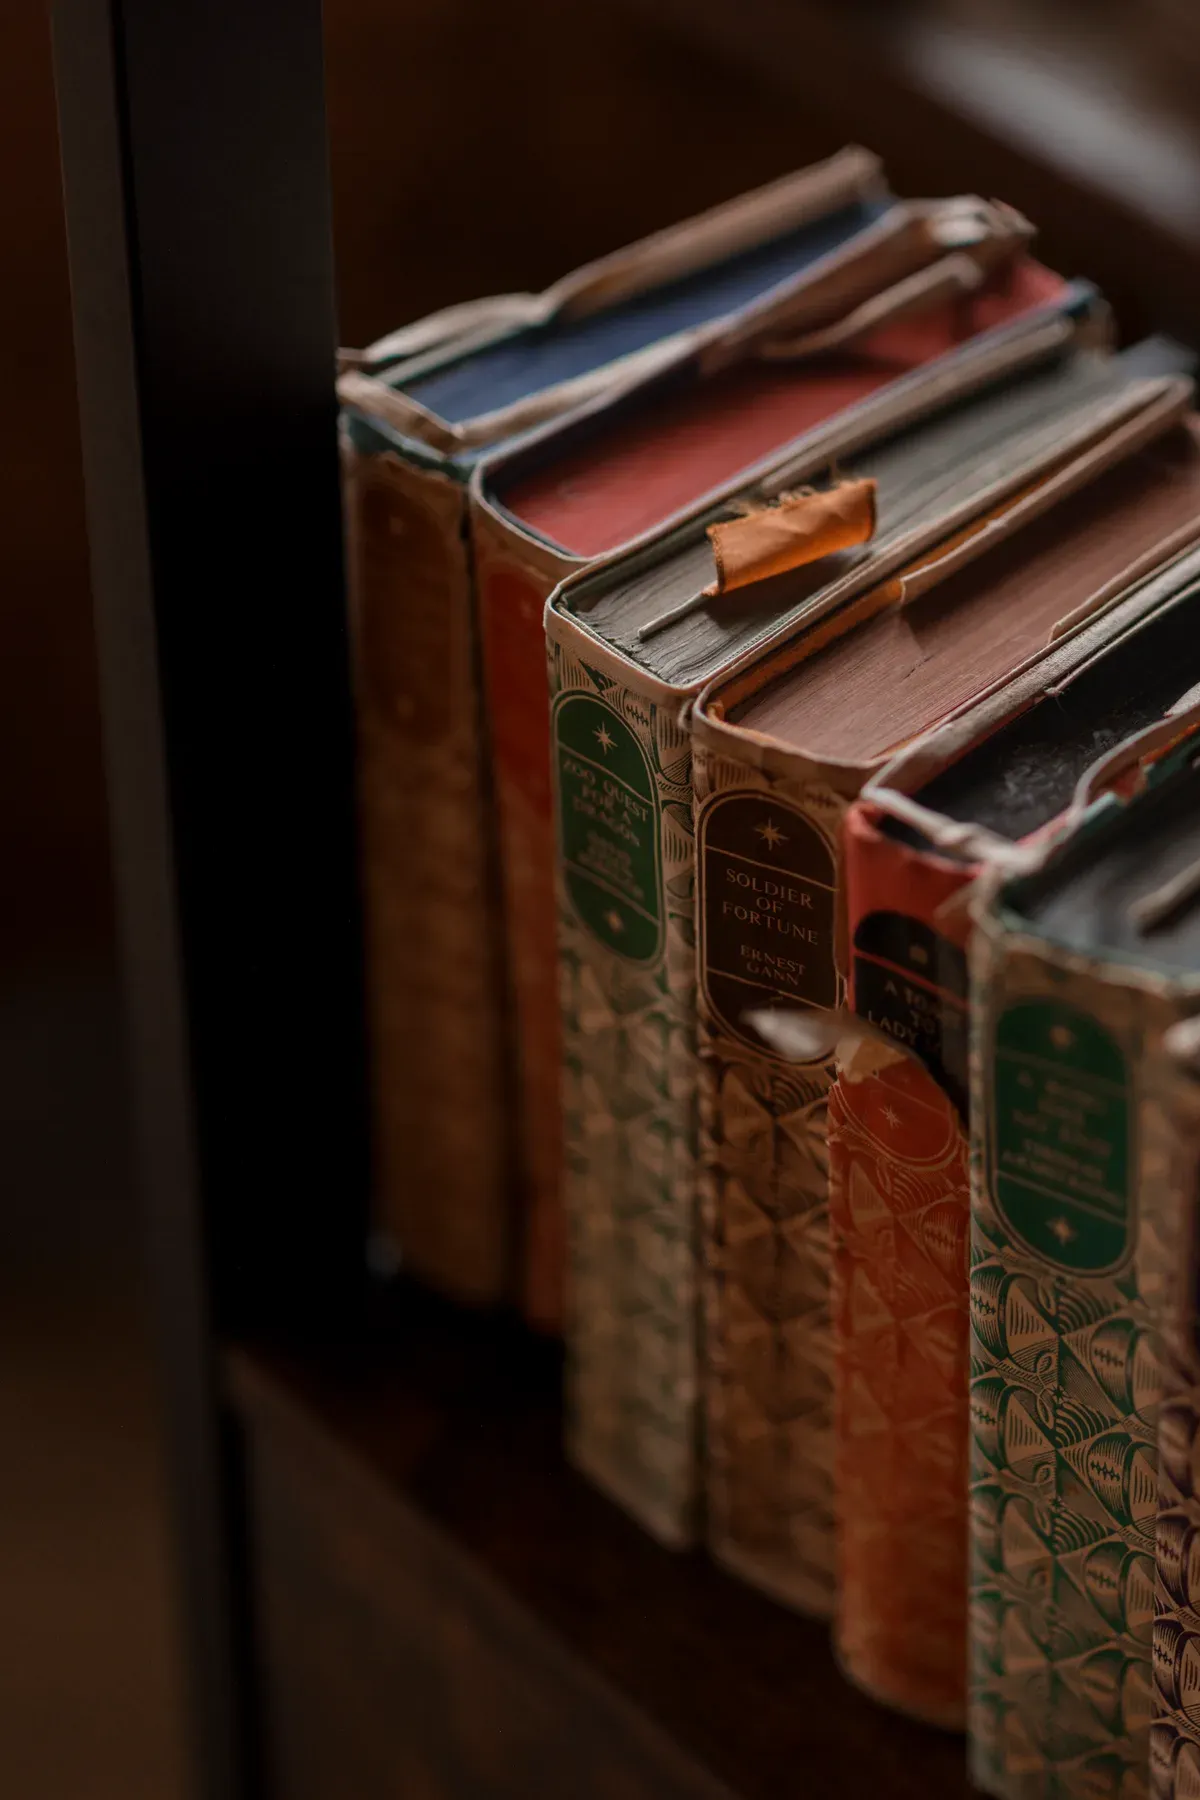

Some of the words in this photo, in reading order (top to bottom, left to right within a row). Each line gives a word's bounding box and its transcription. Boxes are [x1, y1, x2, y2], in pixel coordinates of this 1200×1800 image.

[602, 780, 649, 821] QUEST
[726, 868, 814, 910] SOLDIER
[756, 896, 784, 914] OF
[722, 900, 818, 946] FORTUNE
[740, 944, 807, 975] ERNEST
[746, 961, 799, 987] GANN
[884, 979, 898, 997] A
[868, 1009, 920, 1046] LADY
